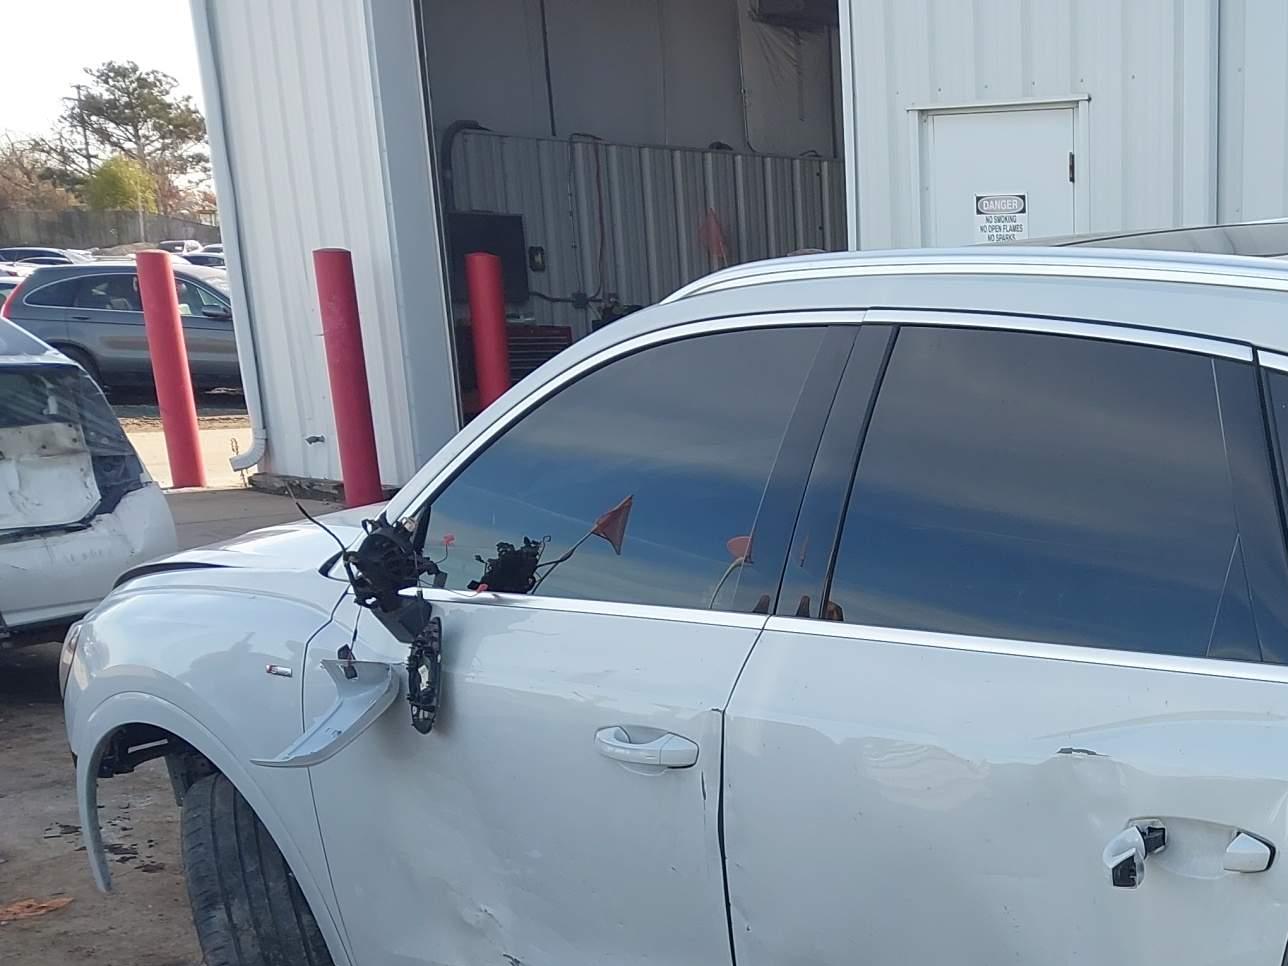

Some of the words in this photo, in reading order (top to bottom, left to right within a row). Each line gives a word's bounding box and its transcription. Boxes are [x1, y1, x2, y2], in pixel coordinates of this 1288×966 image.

[982, 199, 1018, 210] DANGER
[985, 215, 993, 223] NO
[993, 215, 1017, 223] SMOKING
[980, 224, 987, 233] NO
[988, 224, 1002, 232] OPEN
[1002, 224, 1023, 232] FLAMES
[987, 233, 995, 241] NO
[995, 233, 1016, 241] SPARKS
